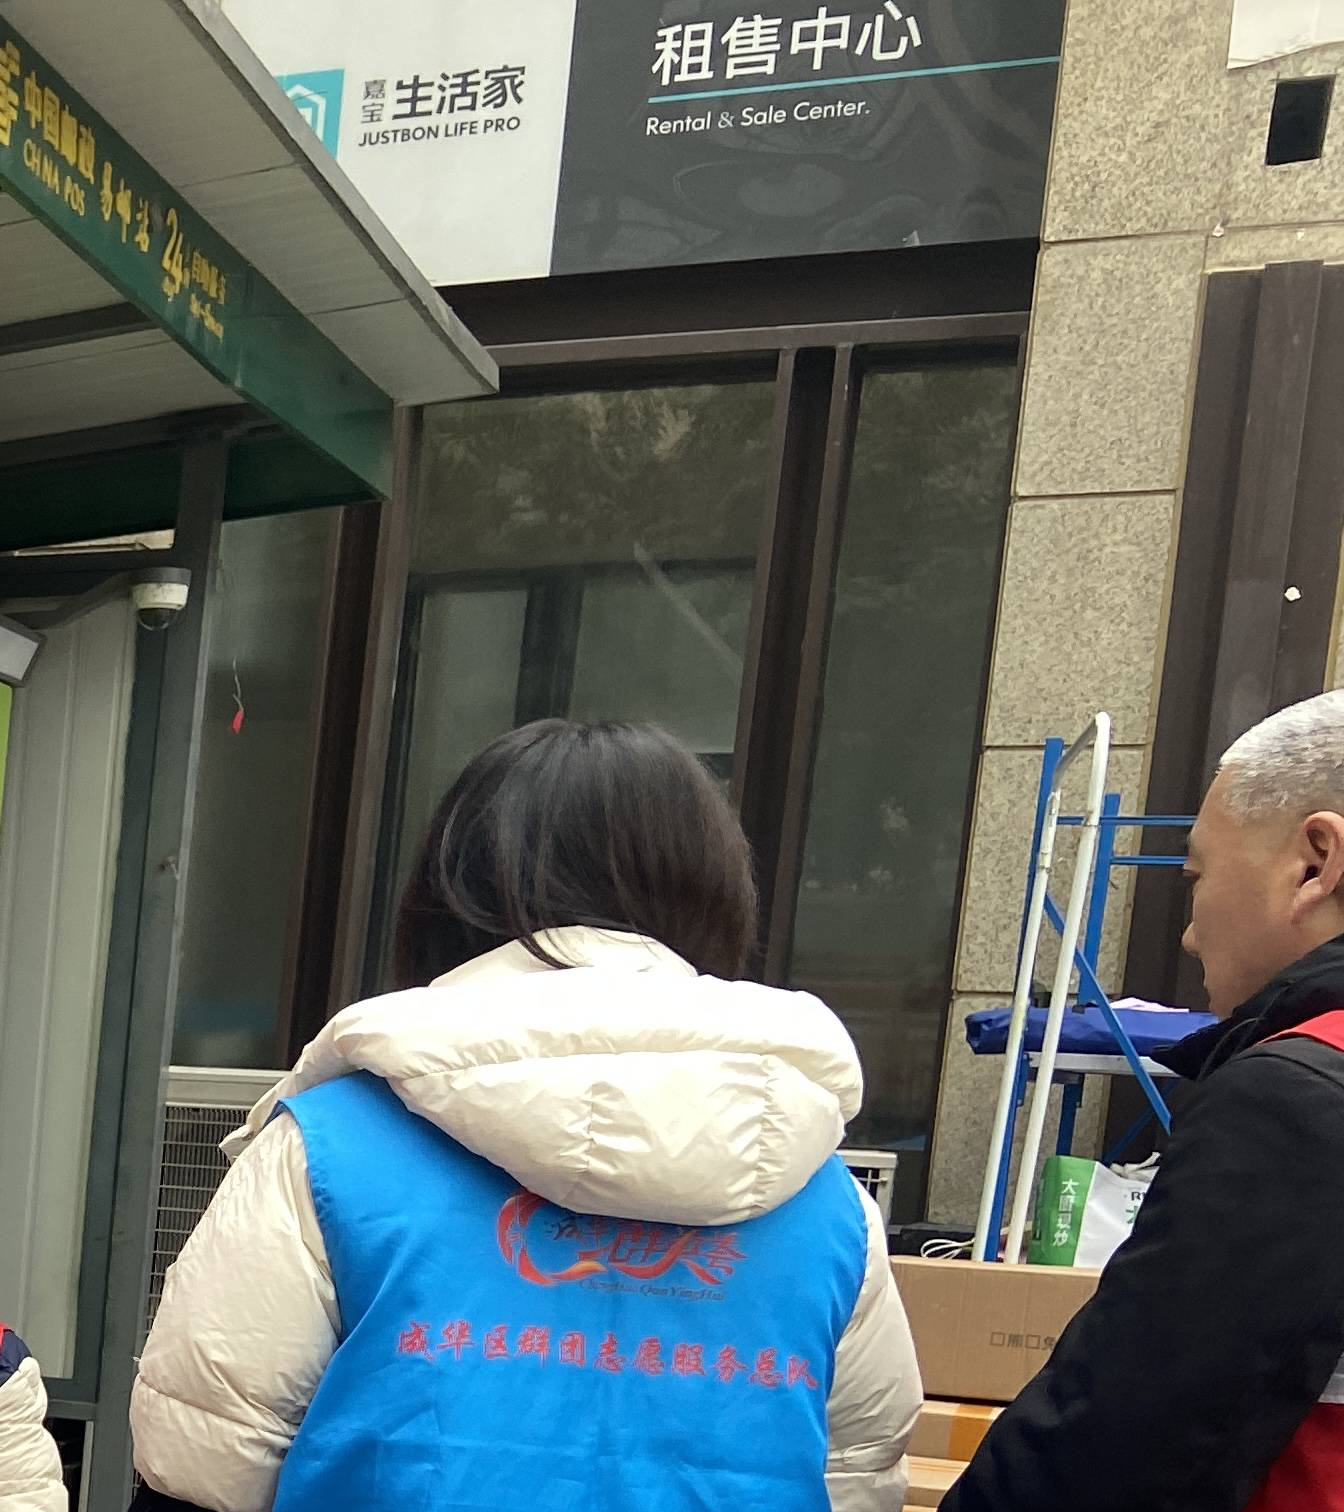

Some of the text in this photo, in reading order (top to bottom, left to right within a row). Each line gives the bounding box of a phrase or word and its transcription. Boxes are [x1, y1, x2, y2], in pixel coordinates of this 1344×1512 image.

[651, 0, 922, 86] 租售中心
[392, 65, 526, 120] 生活家
[358, 116, 521, 147] JUSTBON LIFE PRO
[646, 100, 870, 136] Rental & Sale Center.
